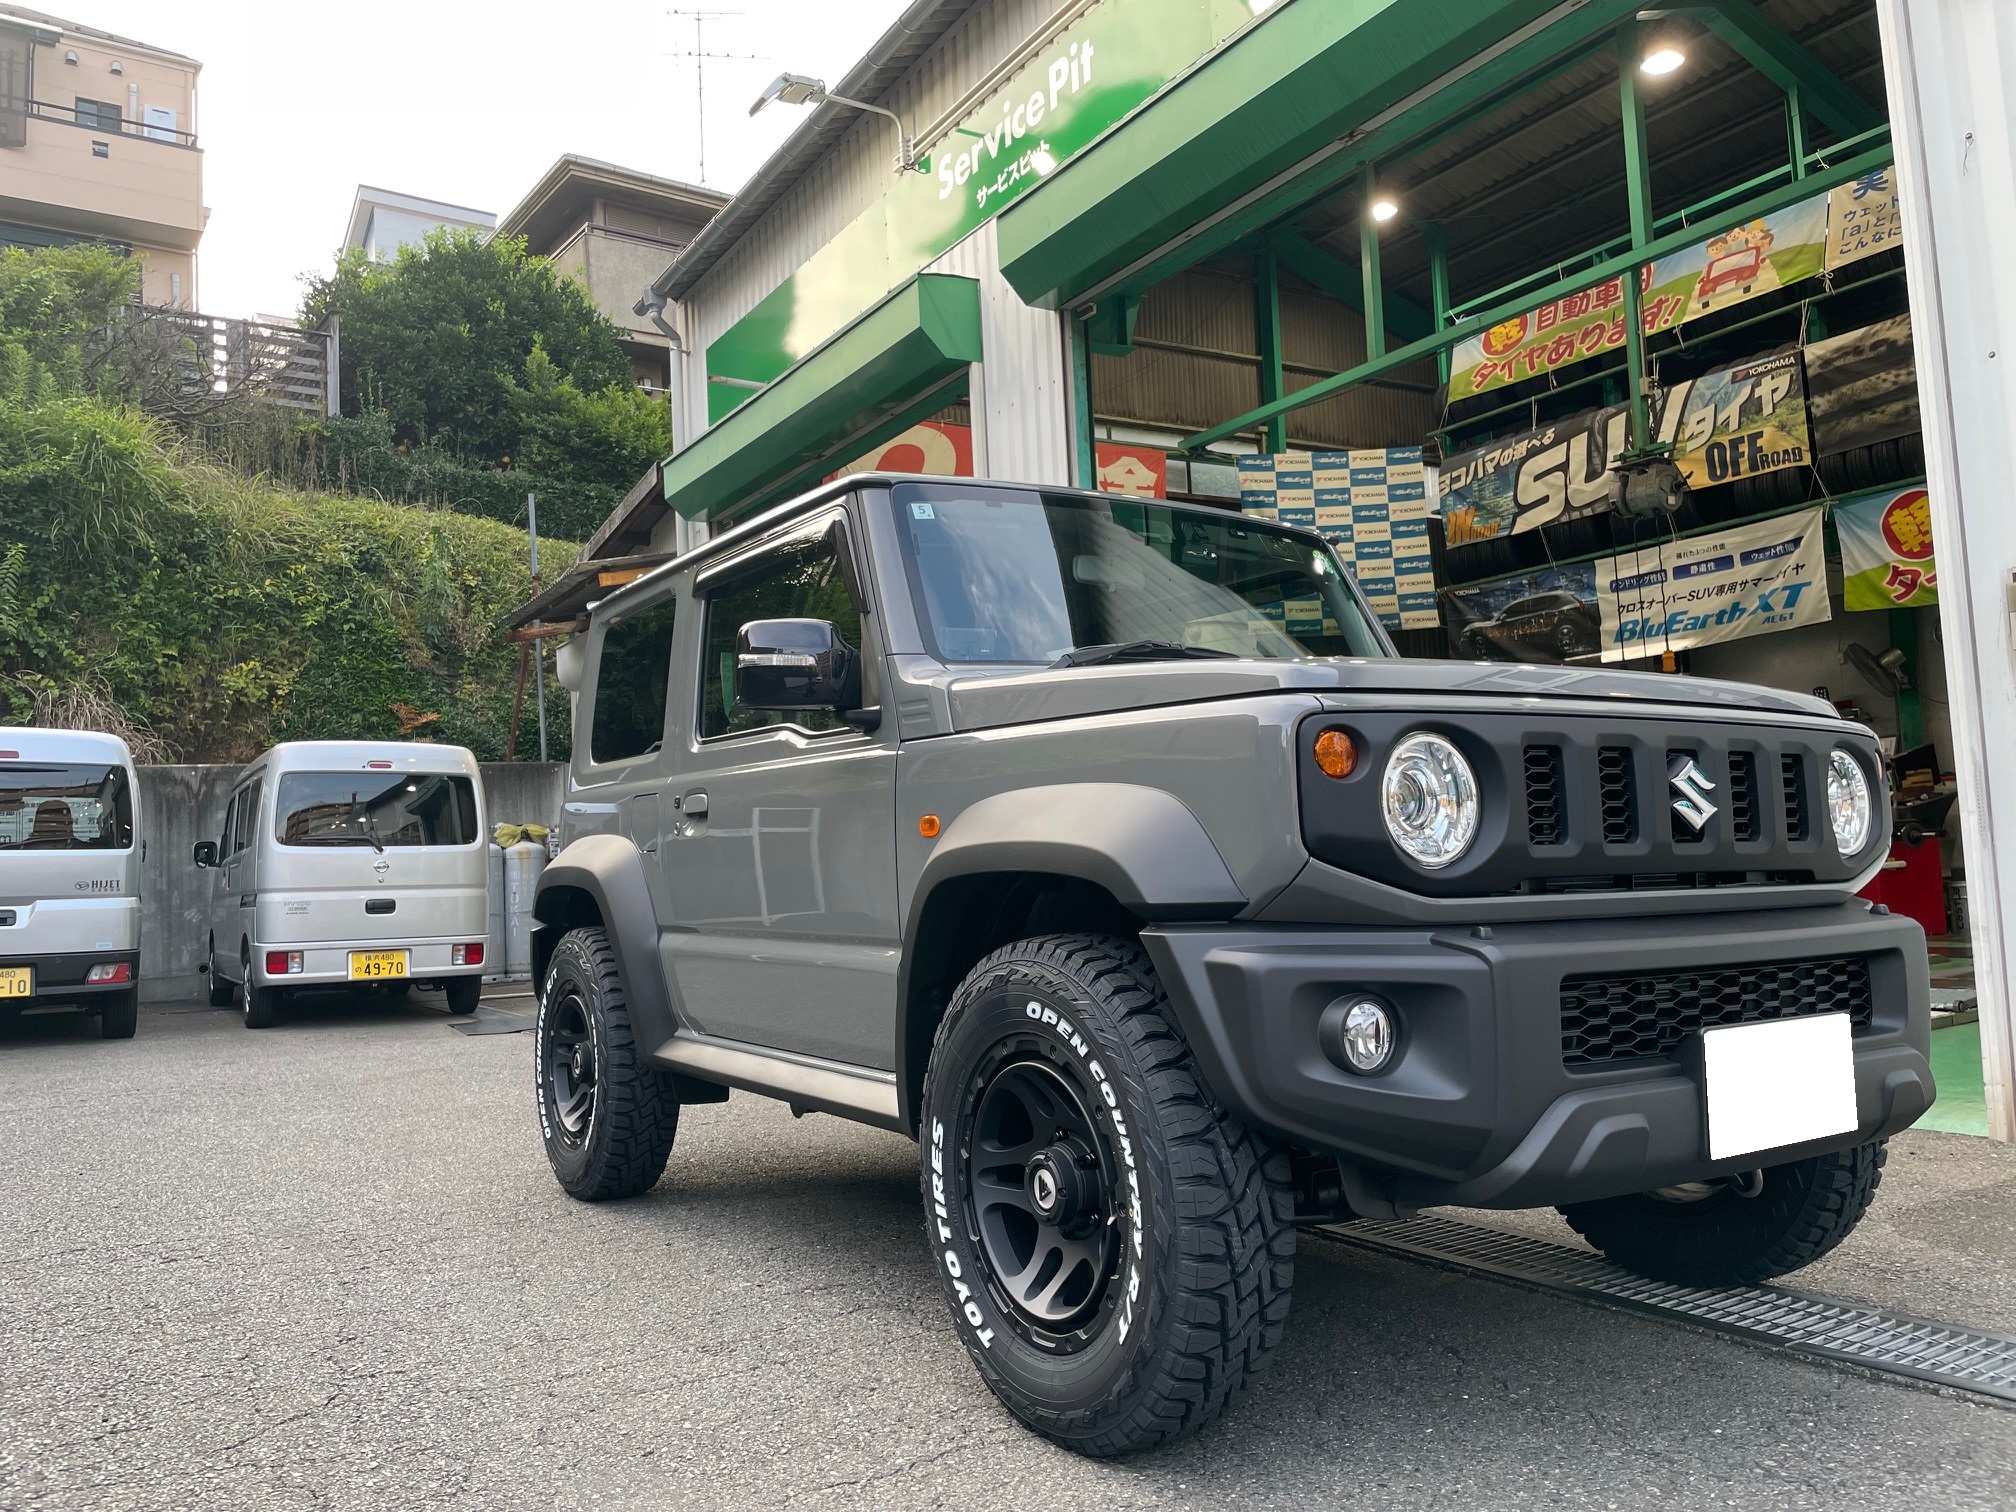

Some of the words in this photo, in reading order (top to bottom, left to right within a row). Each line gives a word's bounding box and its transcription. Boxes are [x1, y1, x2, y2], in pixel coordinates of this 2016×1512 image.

[937, 90, 1045, 200] Service
[1049, 38, 1095, 112] Pit
[1841, 212, 1901, 241] 「a」と「
[1748, 356, 1796, 376] YOKOHAMA
[1705, 430, 1764, 483] OFF
[1758, 446, 1803, 471] ROAD
[918, 505, 926, 514] 5
[1454, 587, 1480, 597] YOKOHAMA
[91, 880, 121, 889] HIJET
[509, 882, 520, 938] TOKAI
[364, 961, 404, 976] 49-70
[381, 953, 395, 961] 480
[536, 992, 548, 1085] COUNTRY
[537, 1088, 551, 1139] OPEN
[1026, 1001, 1090, 1058] OPEN
[1089, 1060, 1143, 1261] COUNTRY
[931, 1115, 954, 1244] TIRES
[944, 1250, 995, 1349] TOYO
